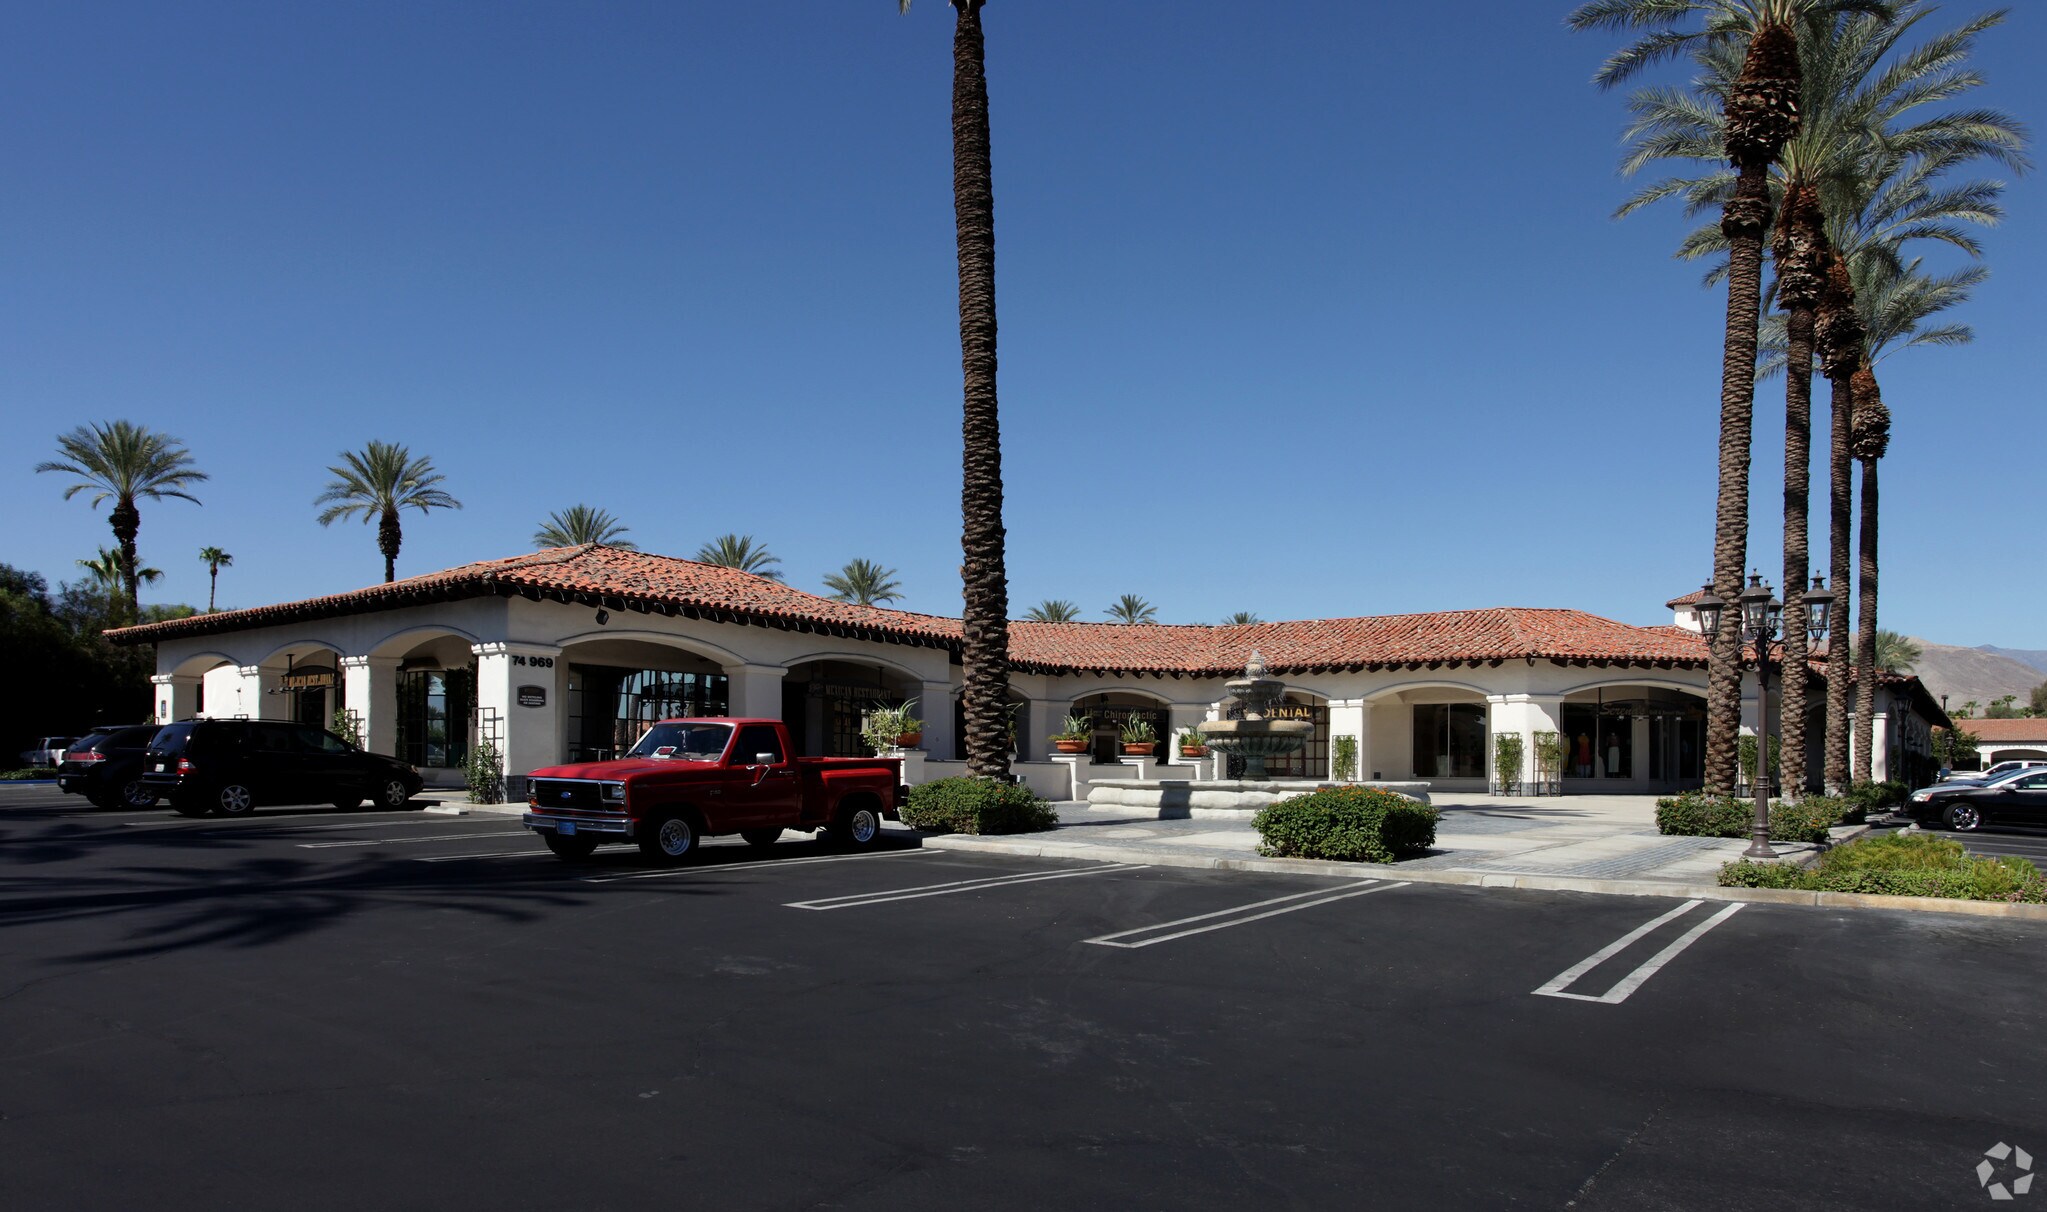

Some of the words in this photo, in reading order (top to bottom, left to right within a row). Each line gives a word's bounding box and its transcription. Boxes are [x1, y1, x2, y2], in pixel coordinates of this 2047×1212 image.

[512, 655, 526, 666] 74
[529, 656, 554, 668] 969
[826, 684, 852, 697] MEXICAN
[854, 686, 892, 700] RESTAURANT
